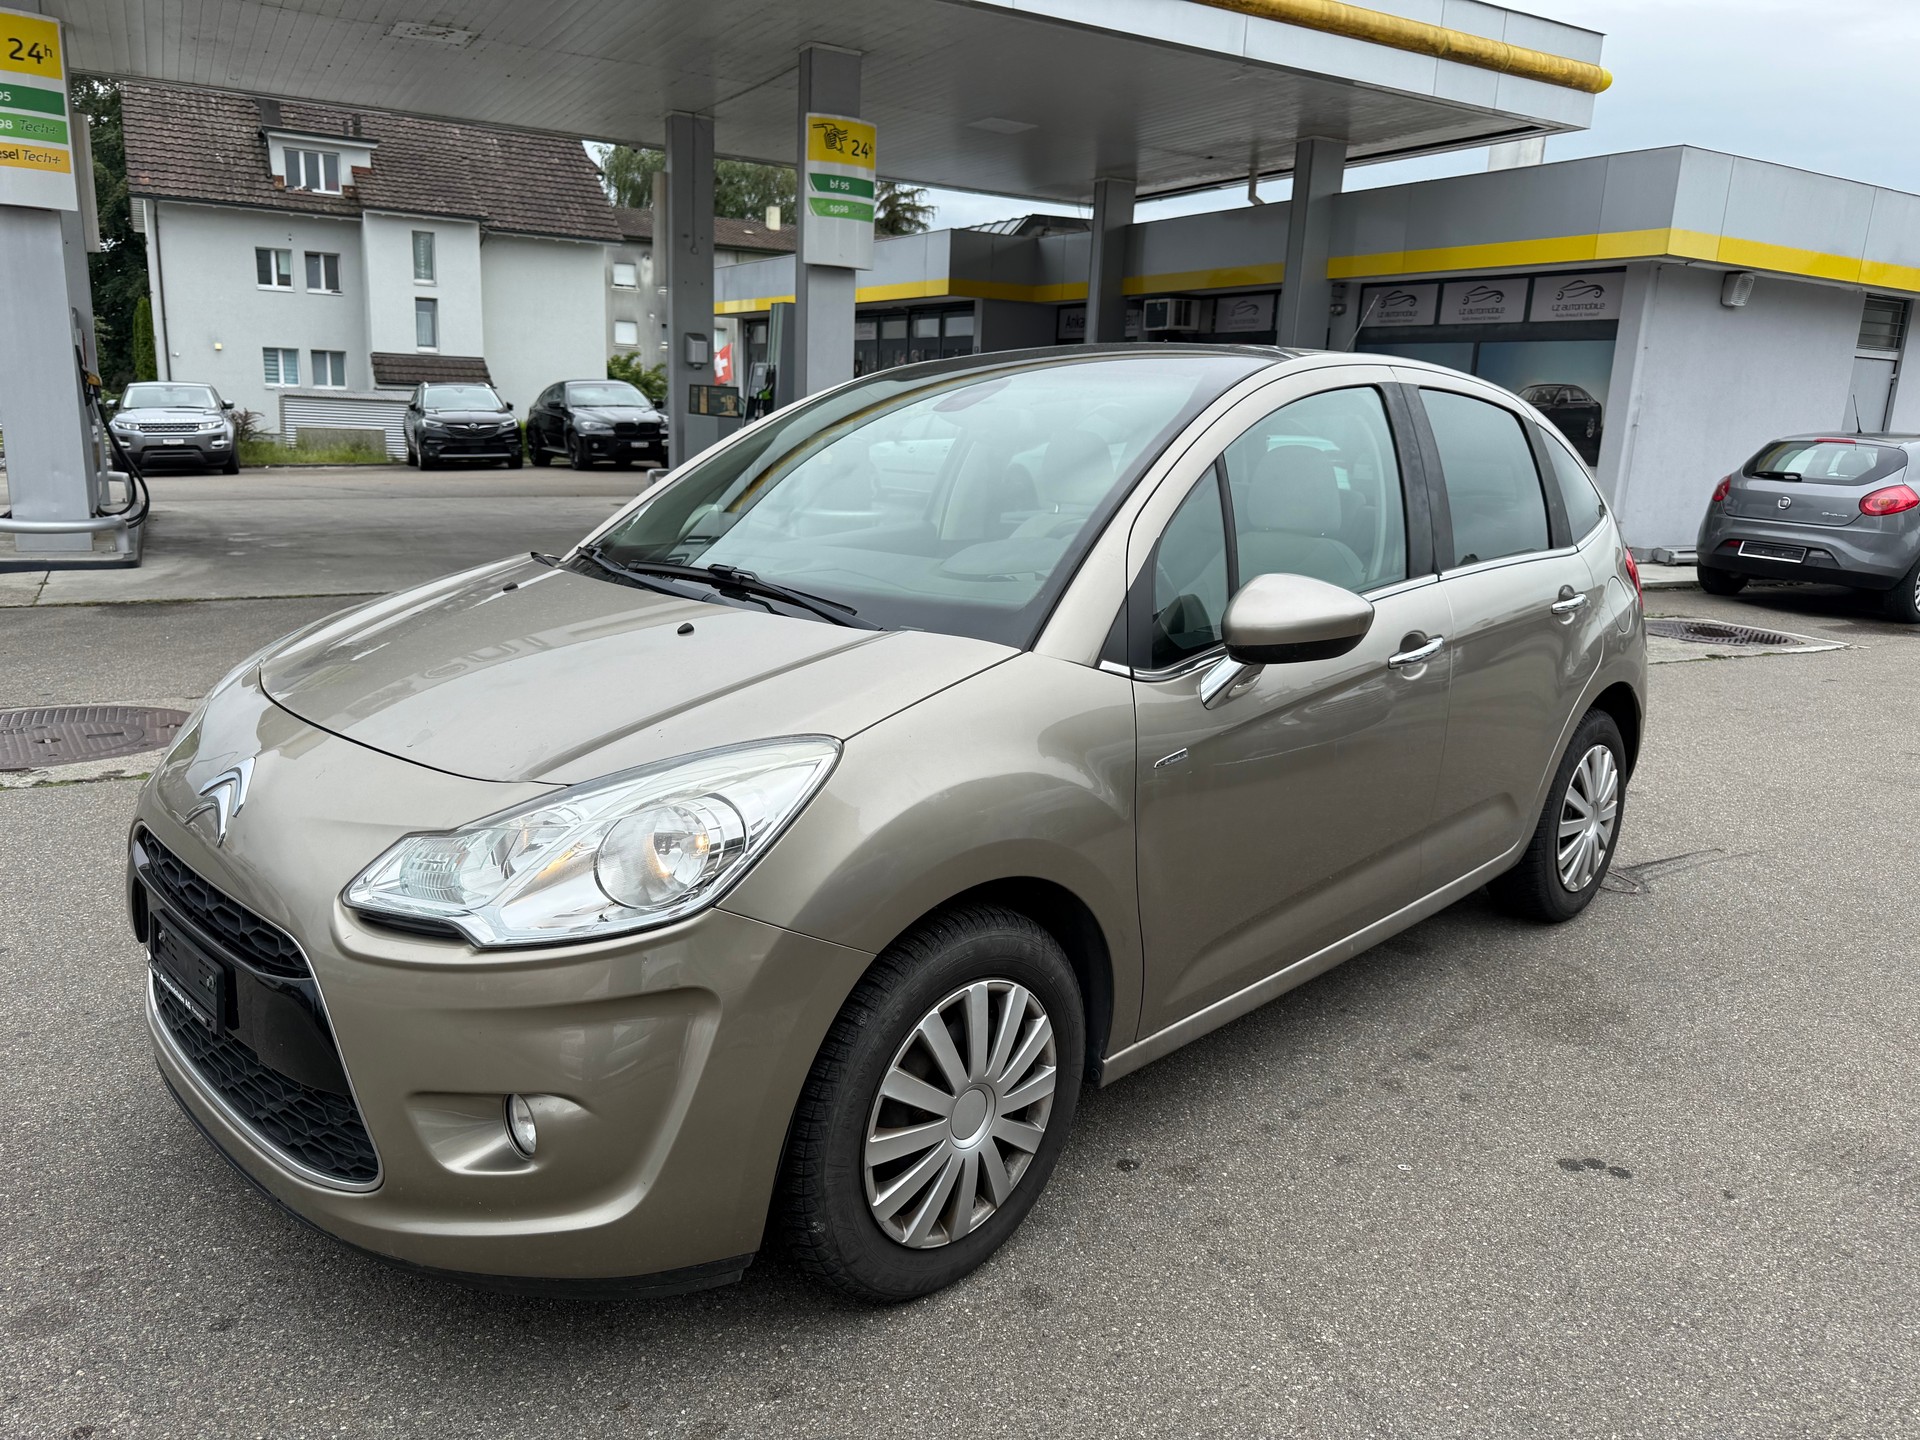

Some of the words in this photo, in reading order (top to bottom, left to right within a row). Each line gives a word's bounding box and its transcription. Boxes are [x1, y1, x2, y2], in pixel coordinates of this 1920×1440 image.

[19, 119, 58, 134] Tech+
[22, 149, 61, 164] Tech+
[829, 179, 839, 188] bf
[840, 181, 850, 191] 95
[1065, 313, 1085, 329] Anka
